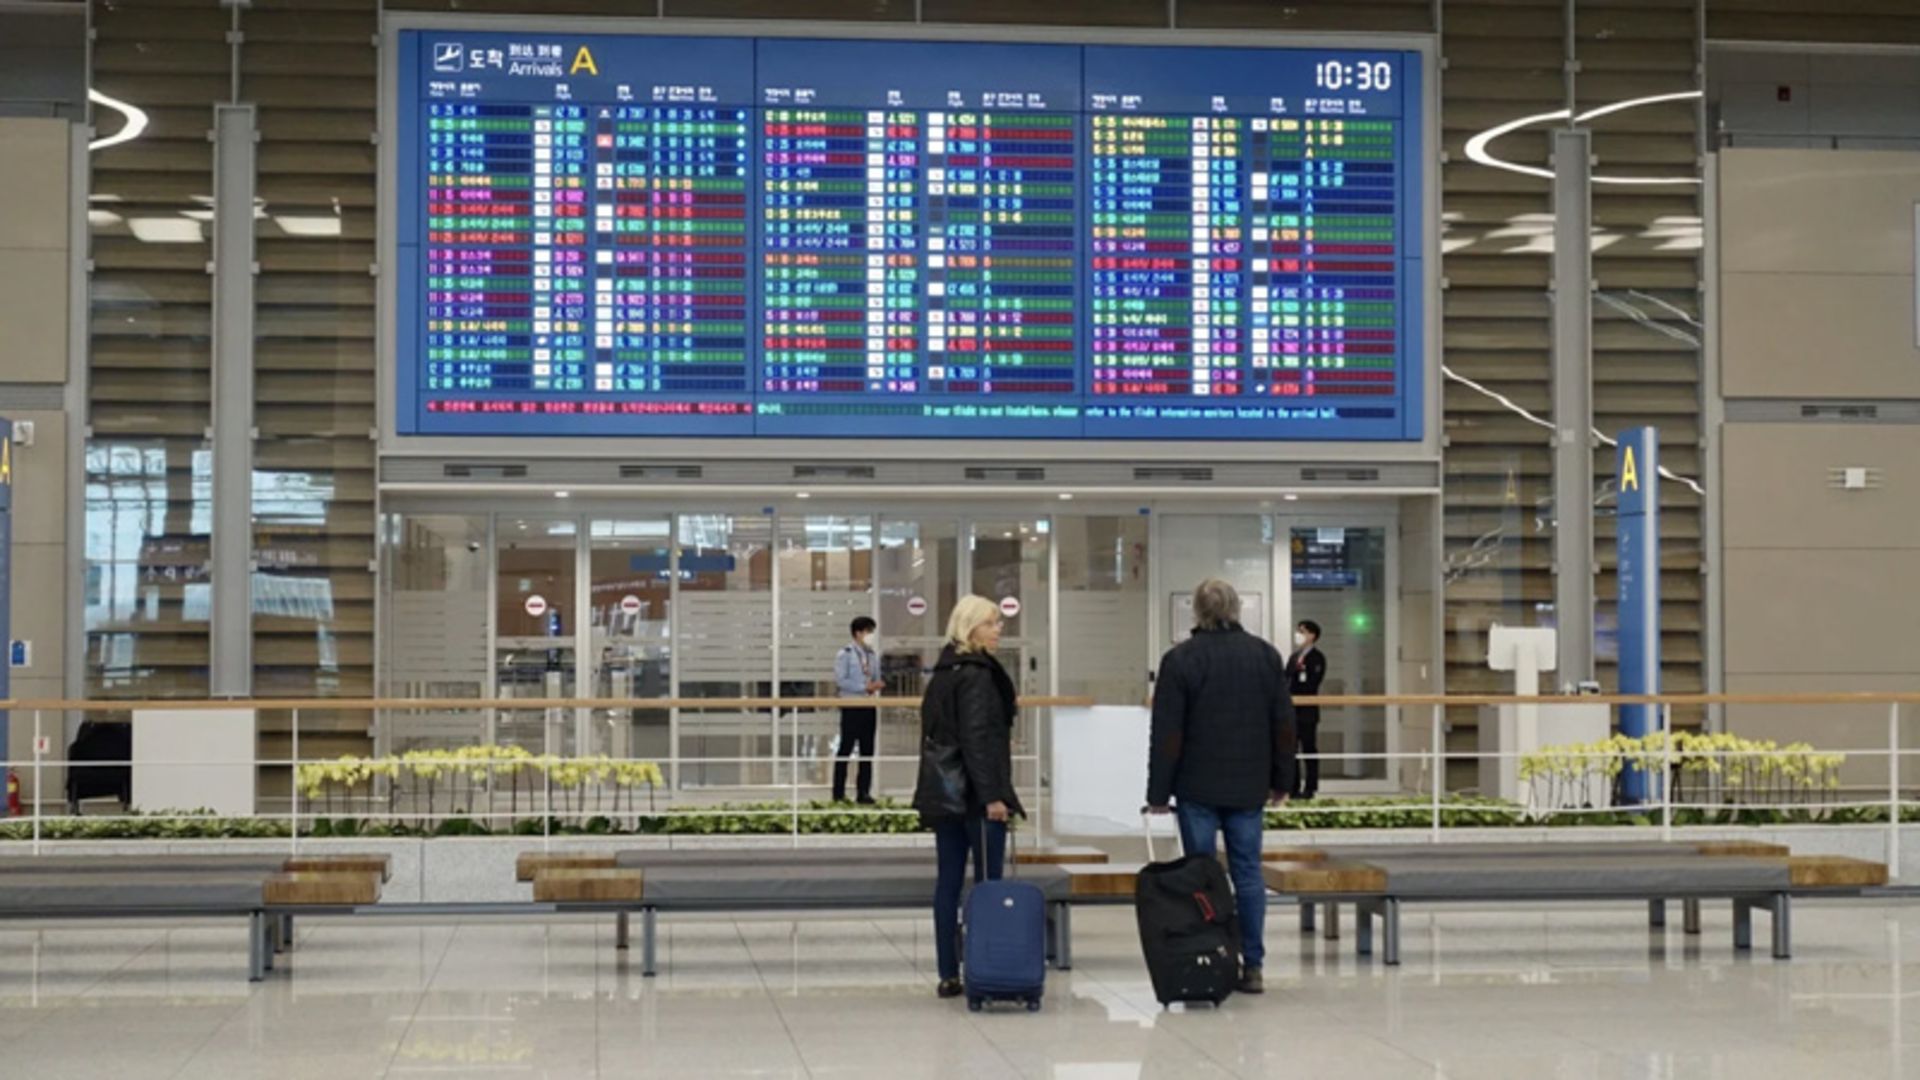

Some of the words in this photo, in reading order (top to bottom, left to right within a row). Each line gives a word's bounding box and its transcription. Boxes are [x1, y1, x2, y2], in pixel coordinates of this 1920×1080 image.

[469, 48, 503, 69] 도착
[508, 61, 563, 77] Arrivals
[570, 46, 598, 75] A
[1316, 61, 1392, 91] 10:30
[1621, 445, 1638, 492] A
